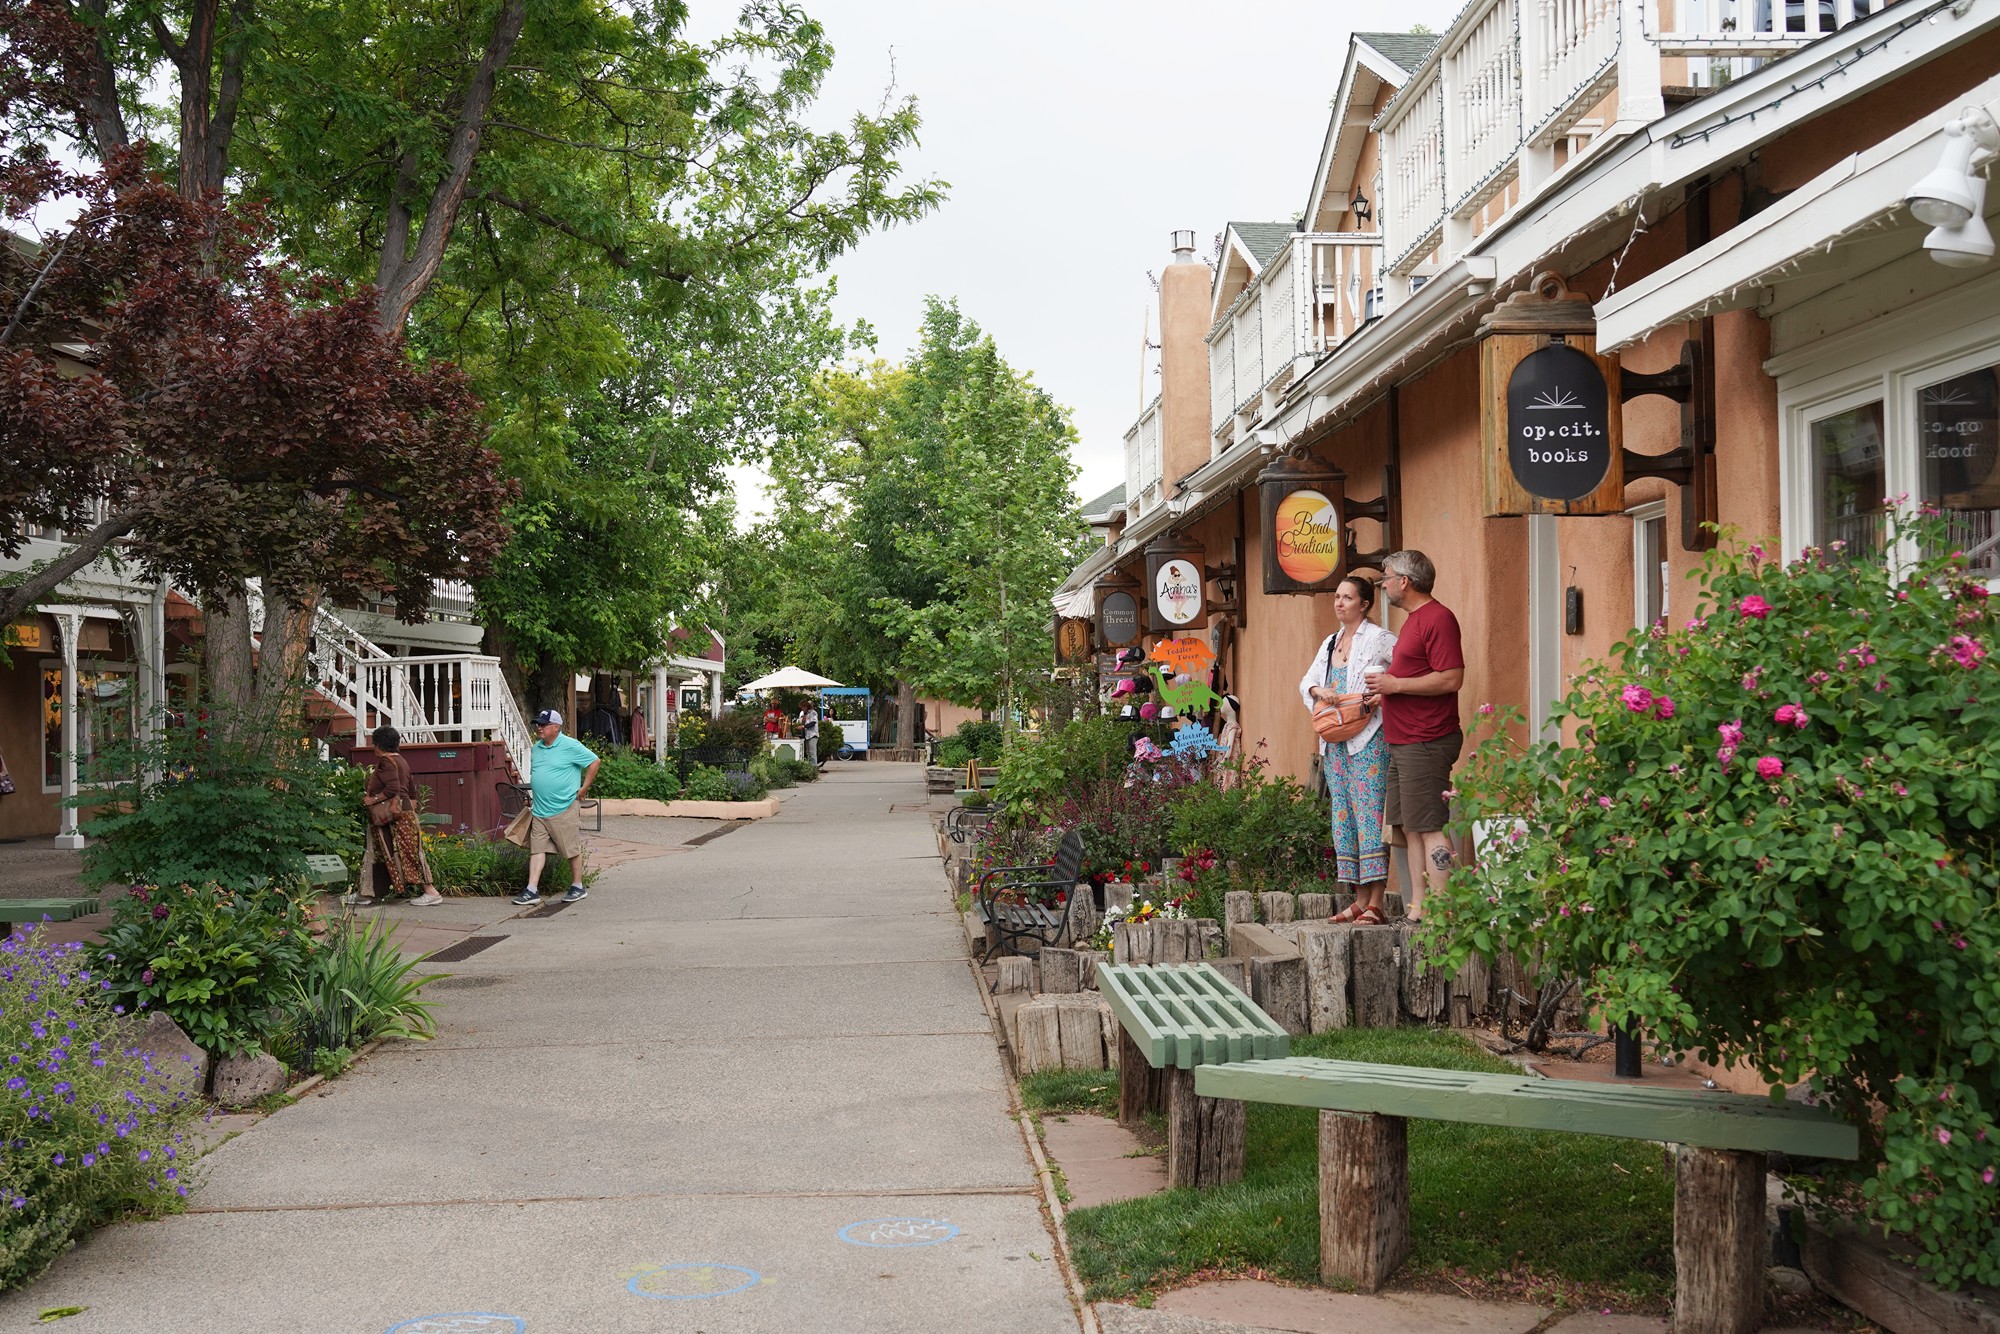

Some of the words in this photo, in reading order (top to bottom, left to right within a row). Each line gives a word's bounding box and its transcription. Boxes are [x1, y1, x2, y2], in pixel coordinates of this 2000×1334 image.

[1523, 421, 1601, 441] op.cit.
[1528, 448, 1589, 463] books
[1293, 511, 1332, 536] Bead
[1279, 531, 1334, 557] Creations
[1103, 608, 1135, 616] Common
[1103, 614, 1135, 624] Thread
[685, 692, 697, 703] M
